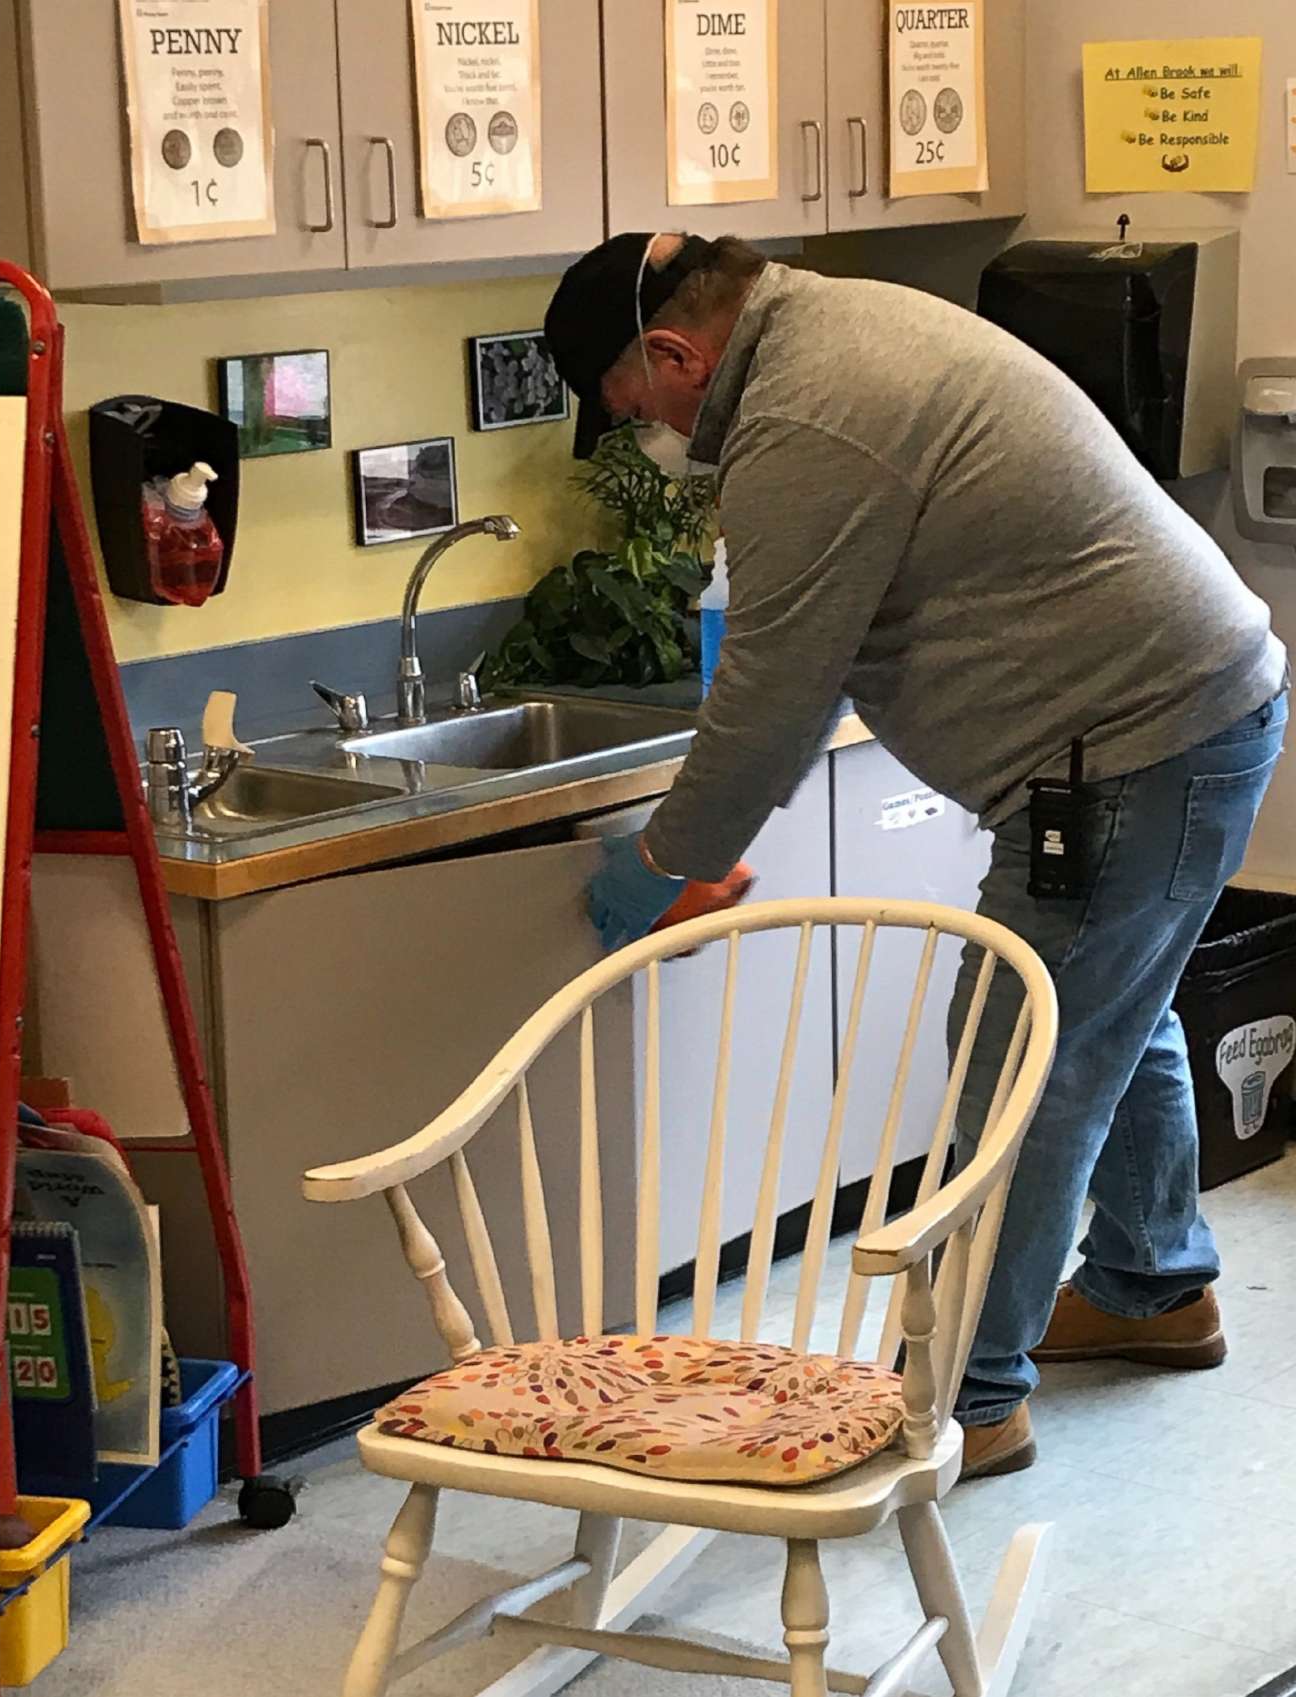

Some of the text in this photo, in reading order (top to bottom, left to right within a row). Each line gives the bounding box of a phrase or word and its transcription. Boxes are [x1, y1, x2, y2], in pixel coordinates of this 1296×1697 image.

[696, 13, 746, 36] DIME
[896, 8, 969, 34] QUARTER
[150, 28, 242, 54] PENNY
[436, 21, 520, 46] NICKEL
[1105, 68, 1120, 80] At
[1127, 66, 1157, 79] Allen
[1163, 65, 1195, 78] Brook
[1200, 68, 1214, 77] we
[1160, 86, 1211, 99] Be Safe
[1162, 109, 1209, 122] Be Kind
[915, 140, 944, 164] 25¢
[1138, 132, 1229, 148] Be Responsible
[709, 143, 741, 168] 10¢
[471, 161, 495, 186] 5¢
[191, 178, 218, 207] 1¢
[1219, 1028, 1247, 1075] Feed
[14, 1307, 49, 1329] 15
[17, 1360, 56, 1383] 20
